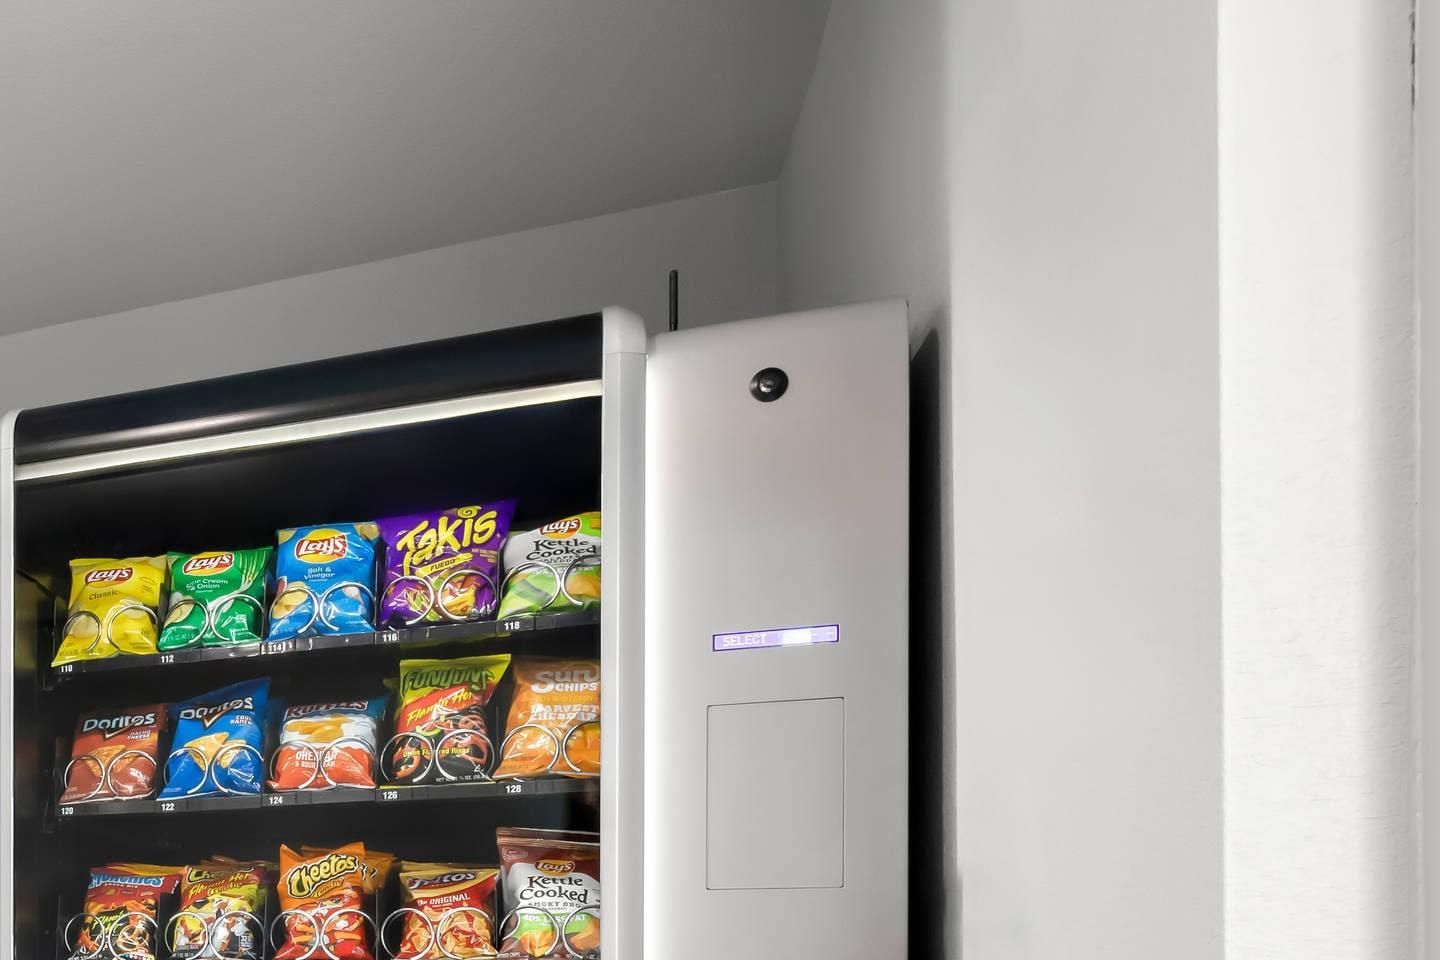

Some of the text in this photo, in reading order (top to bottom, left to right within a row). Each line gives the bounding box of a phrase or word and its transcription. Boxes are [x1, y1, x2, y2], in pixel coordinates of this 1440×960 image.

[396, 506, 497, 576] Takis
[533, 539, 589, 551] Kettle
[527, 545, 597, 560] Cooked
[430, 559, 456, 571] FUEGO
[304, 571, 335, 580] Vinegar
[89, 590, 119, 600] Classic
[504, 622, 520, 630] 118
[382, 634, 398, 642] 116
[723, 634, 767, 646] SELECT
[161, 655, 174, 663] 112
[60, 665, 72, 673] 110
[555, 682, 598, 691] CHIPS
[83, 713, 156, 732] Doritos
[506, 785, 521, 793] 128
[270, 796, 283, 805] 124
[162, 803, 175, 811] 122
[289, 854, 356, 897] Cheetos
[528, 876, 583, 888] Kettle
[430, 893, 471, 905] ORIGINAL
[520, 886, 588, 904] Cooked
